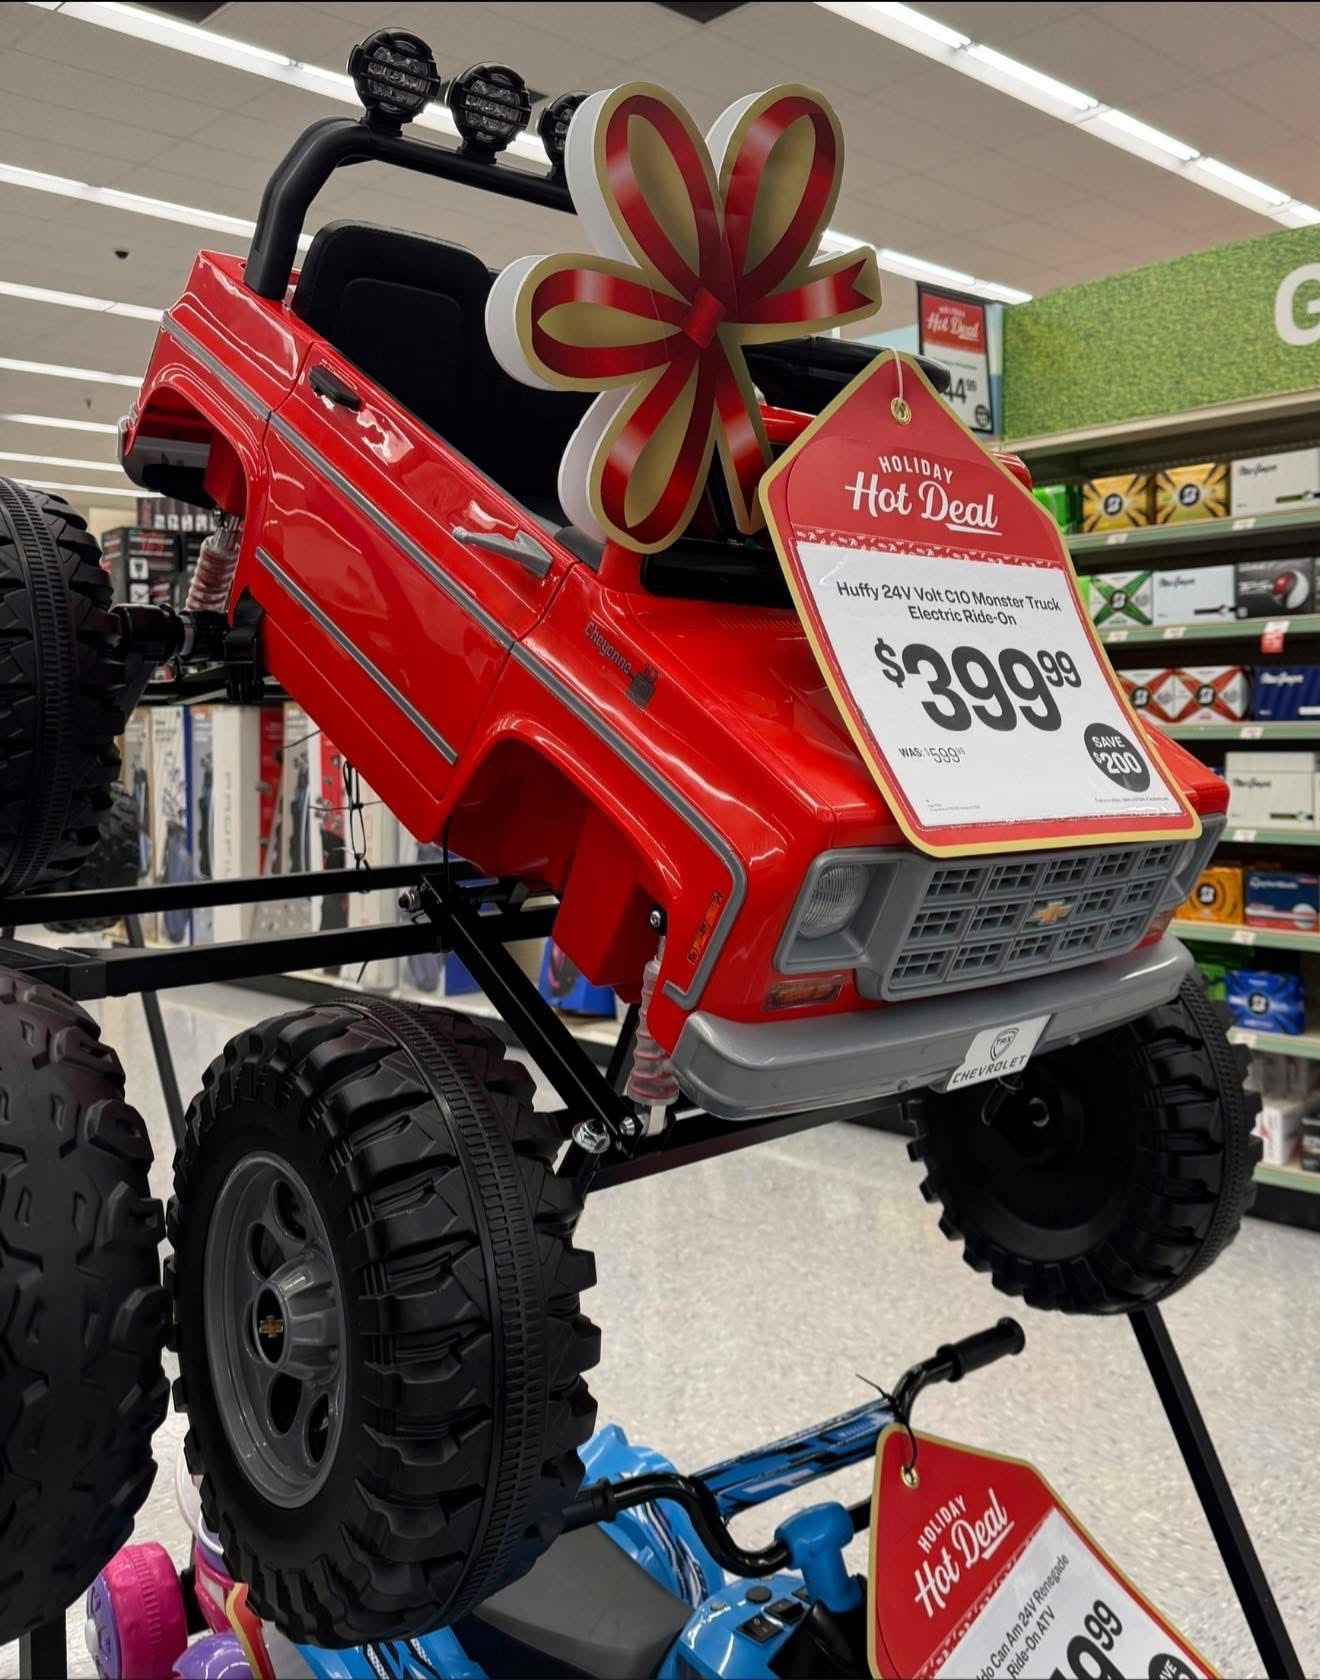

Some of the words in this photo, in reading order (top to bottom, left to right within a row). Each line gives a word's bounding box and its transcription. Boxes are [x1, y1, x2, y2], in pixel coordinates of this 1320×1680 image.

[878, 455, 952, 484] HOLIDAY
[844, 471, 913, 518] Hot
[918, 480, 999, 530] Deal
[836, 581, 879, 601] Huffy
[881, 584, 911, 601] 24V
[913, 586, 943, 602] Volt
[944, 589, 971, 605] C10
[972, 591, 1024, 609] Monster
[1025, 596, 1062, 612] Truck
[907, 605, 962, 622] Electric
[963, 609, 1017, 626] Ride-On
[584, 620, 632, 675] Cheyenne
[898, 747, 925, 758] WAS:
[1091, 736, 1126, 748] SAVE
[1092, 751, 1142, 774] $200
[952, 1054, 1028, 1085] CHEVROLET
[917, 1495, 967, 1555] HOLIDAY
[914, 1546, 960, 1618] Hot
[951, 1487, 1008, 1569] Deal
[990, 1643, 1011, 1669] Can
[1006, 1623, 1024, 1648] Am
[1018, 1597, 1037, 1628] 24V
[1032, 1554, 1069, 1605] Renegade
[1006, 1632, 1041, 1680] Ride-On
[1036, 1604, 1055, 1636] ATV
